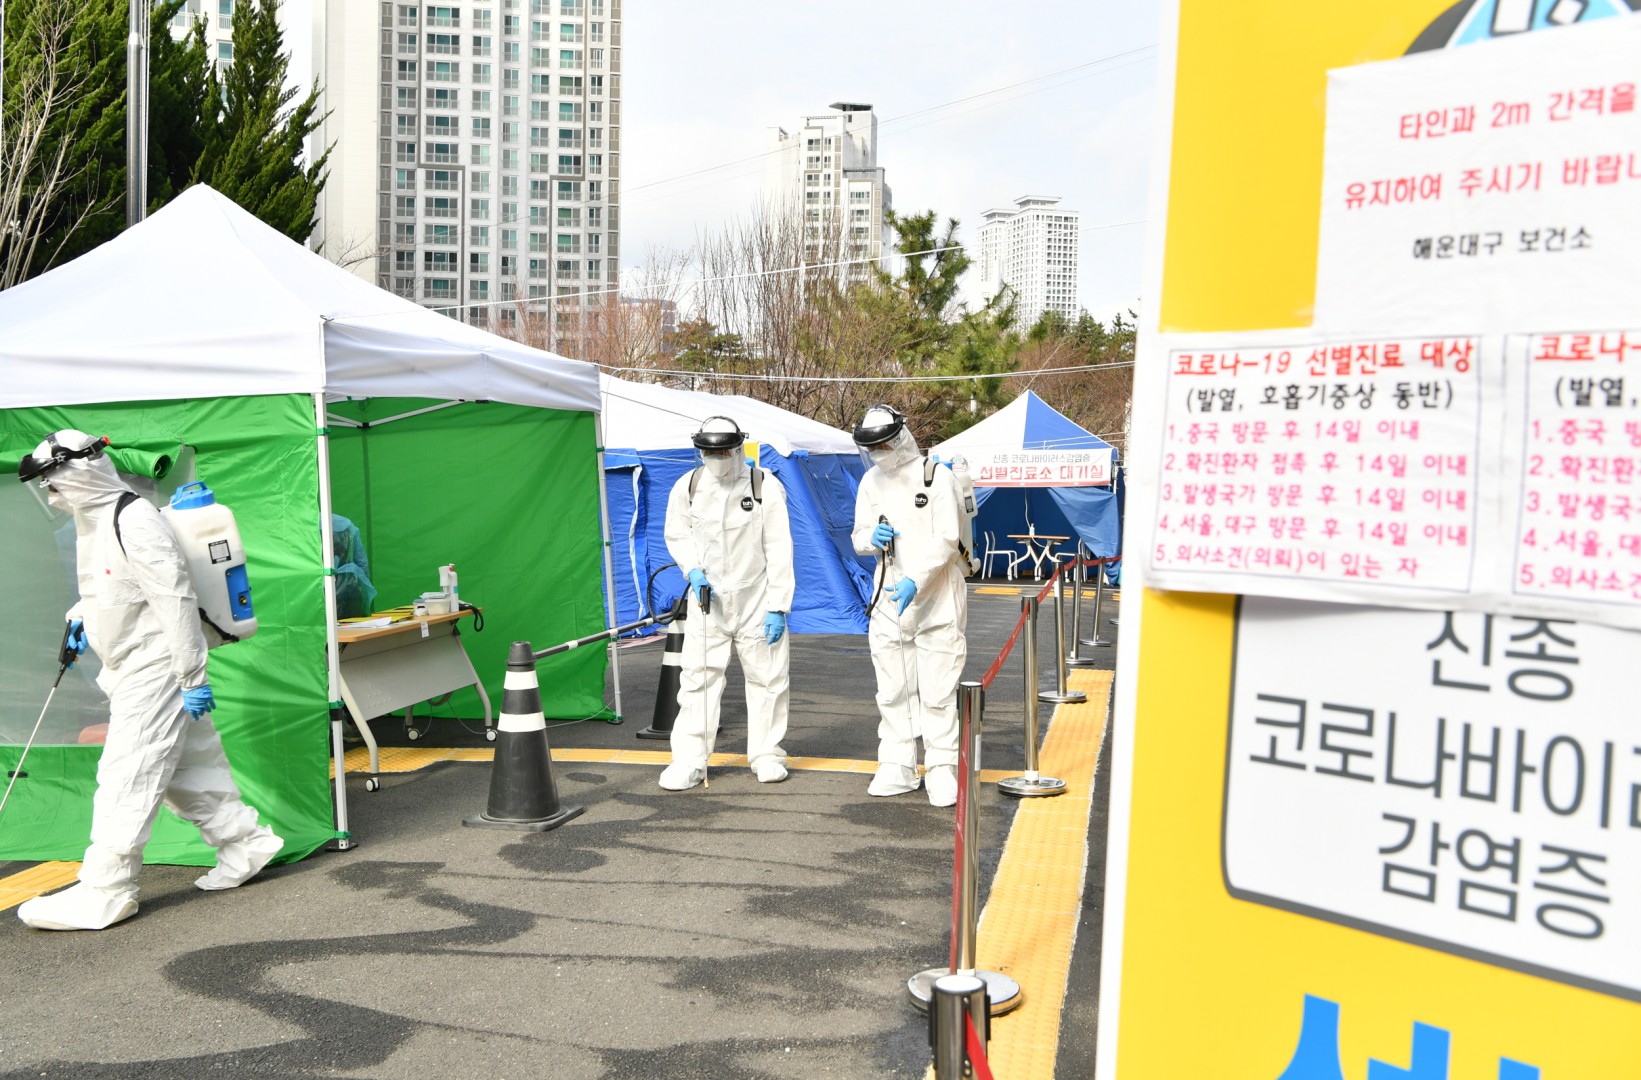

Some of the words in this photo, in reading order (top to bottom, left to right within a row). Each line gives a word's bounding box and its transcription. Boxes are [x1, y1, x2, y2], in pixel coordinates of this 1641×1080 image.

[1399, 105, 1476, 140] 타인과
[1490, 101, 1532, 129] 2m
[1548, 83, 1636, 122] 간격을
[1345, 173, 1443, 210] 유지하여
[1458, 161, 1543, 198] 주시기
[1412, 231, 1503, 260] 해운대구
[1519, 226, 1591, 253] 보건소
[1173, 351, 1292, 377] 코로나-19
[1306, 343, 1405, 377] 선별진료
[1420, 340, 1474, 374] 대상
[1186, 388, 1243, 413] (발열,
[1259, 383, 1377, 411] 호흡기증상
[1392, 380, 1454, 410] 동반)
[1231, 420, 1269, 445] 방문
[1282, 420, 1299, 440] 후
[1315, 419, 1361, 444] 14일
[1377, 420, 1420, 441] 이내
[979, 466, 1052, 481] 선별진료소
[1059, 464, 1103, 480] 대기실
[993, 453, 1009, 464] 신종
[1011, 453, 1092, 464] 코로나바이러스감염증
[1271, 451, 1306, 476] 접촉
[1320, 451, 1339, 473] 후
[1357, 453, 1407, 479] 14일
[1423, 454, 1467, 477] 이내
[1267, 484, 1303, 508] 방문
[1317, 484, 1336, 505] 후
[1355, 487, 1406, 513] 14일
[1422, 489, 1467, 512] 이내
[1268, 516, 1307, 541] 방문
[1321, 517, 1341, 539] 후
[1358, 521, 1408, 547] 14일
[1423, 524, 1468, 547] 이내
[1340, 552, 1383, 579] 있는
[1397, 557, 1419, 578] 자
[1427, 612, 1580, 702] 신종
[1378, 812, 1611, 940] 감염증
